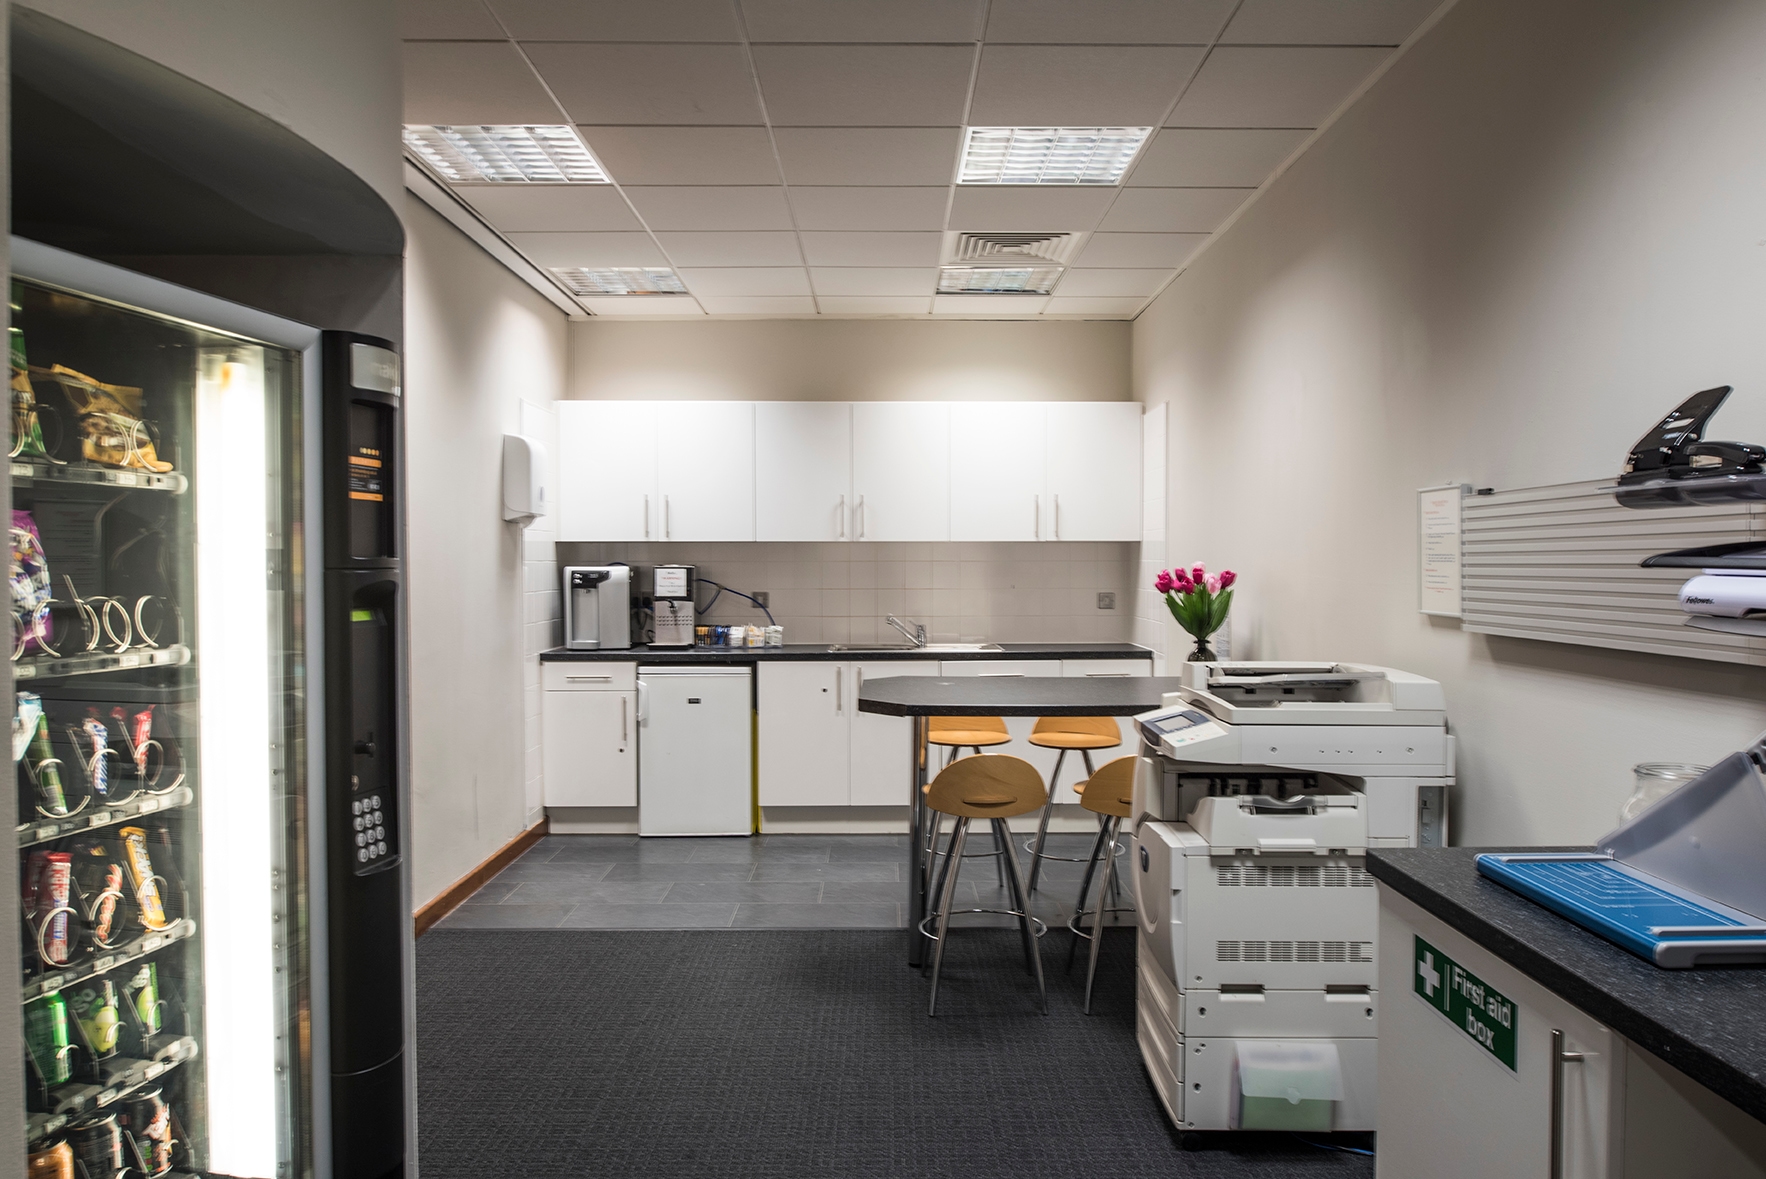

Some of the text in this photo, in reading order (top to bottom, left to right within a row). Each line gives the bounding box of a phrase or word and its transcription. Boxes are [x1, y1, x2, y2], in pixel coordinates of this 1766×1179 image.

[1451, 965, 1511, 1029] First aid
[1466, 1007, 1495, 1051] box
